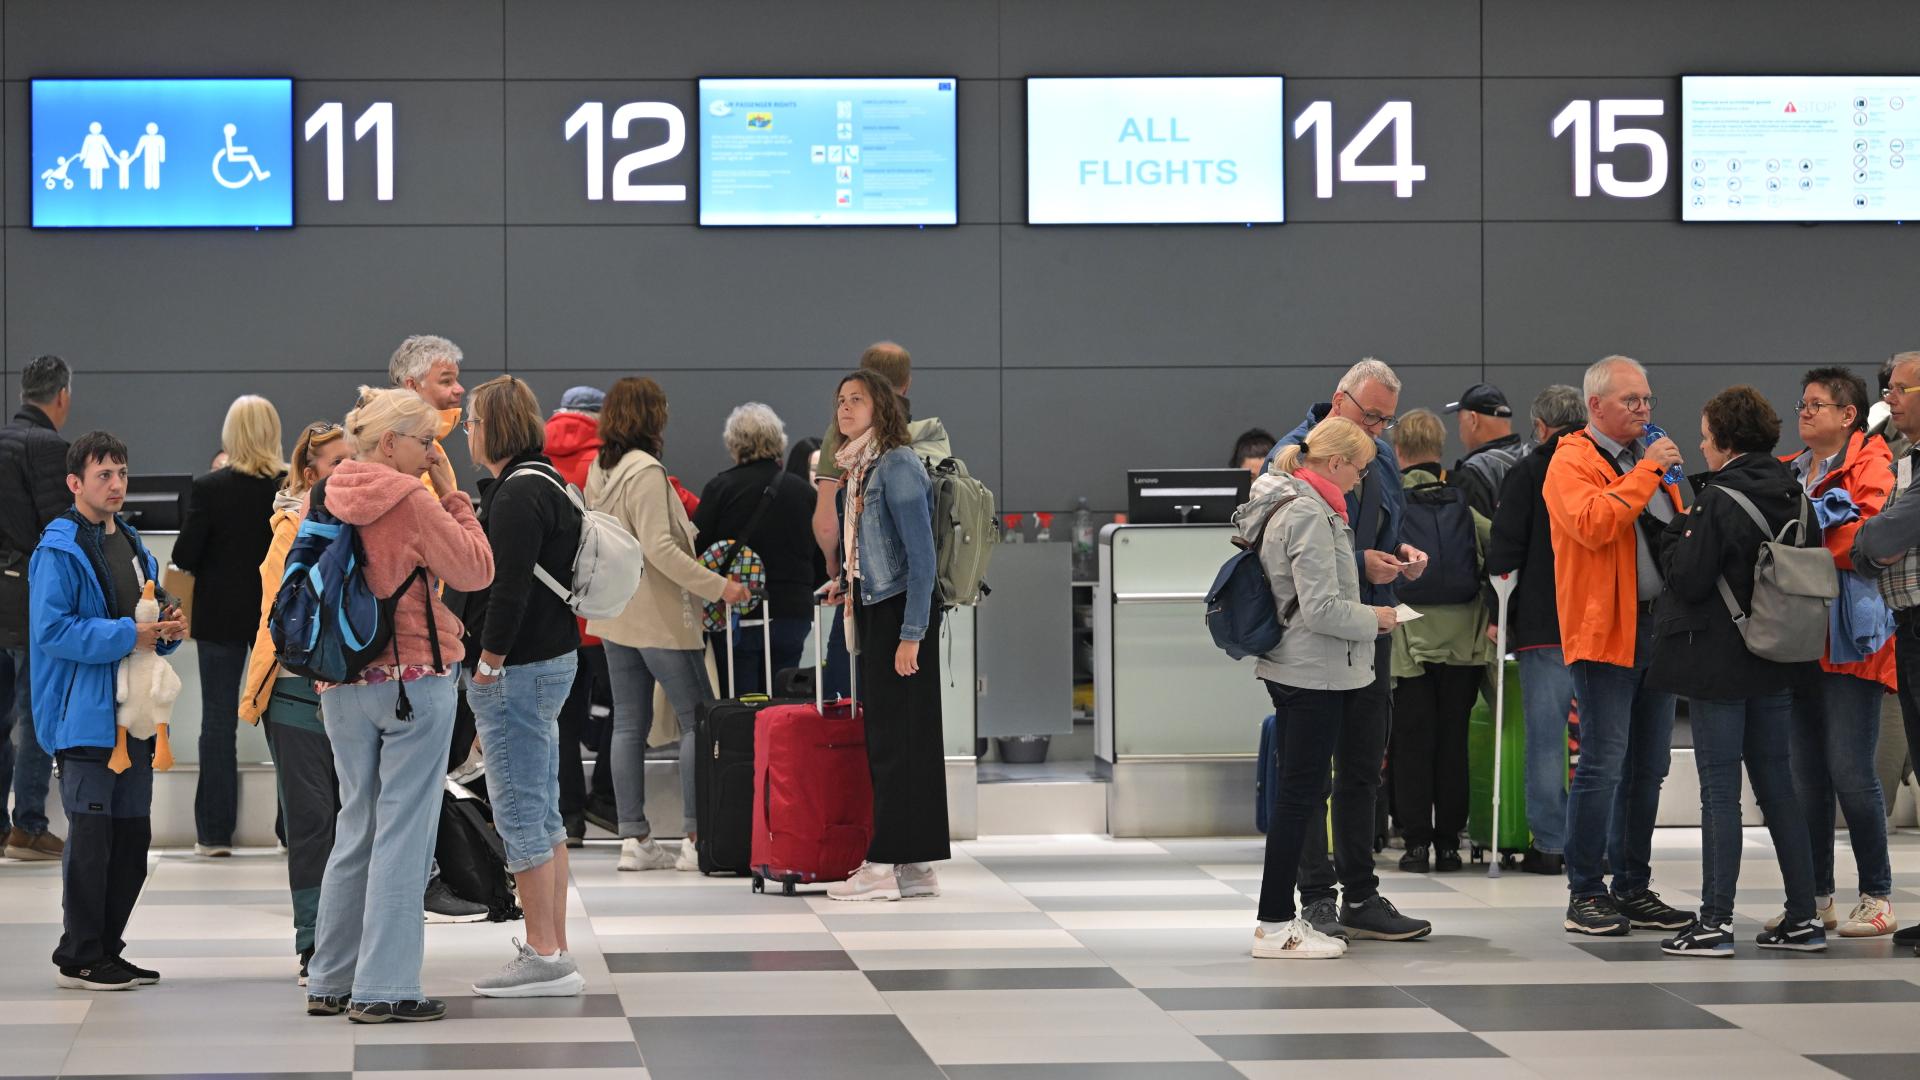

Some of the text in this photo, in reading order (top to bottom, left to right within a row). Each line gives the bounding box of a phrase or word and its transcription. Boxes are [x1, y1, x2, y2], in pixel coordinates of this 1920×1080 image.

[305, 102, 394, 201] 11
[565, 102, 687, 201] 12
[1079, 159, 1239, 186] FLIGHTS
[1118, 117, 1190, 143] ALL
[1294, 101, 1426, 199] 14
[1551, 100, 1669, 198] 15
